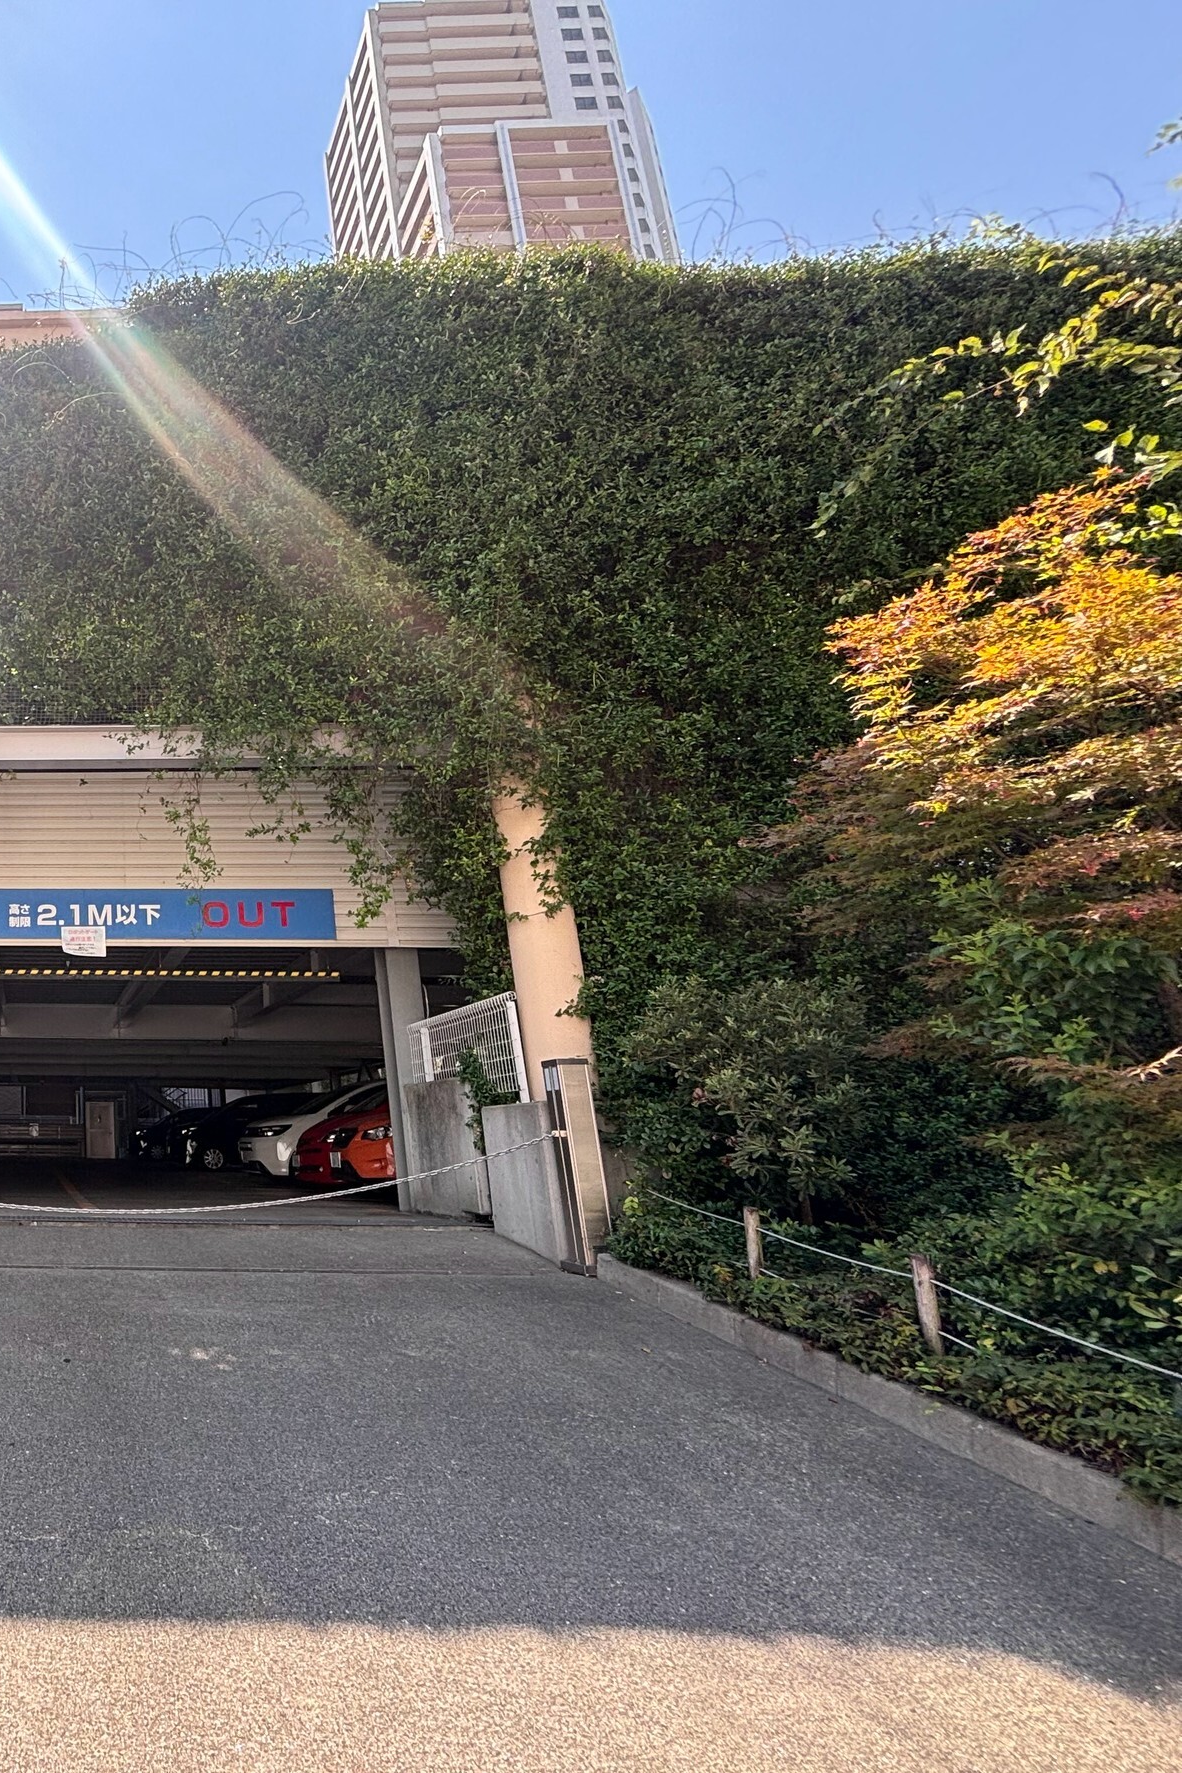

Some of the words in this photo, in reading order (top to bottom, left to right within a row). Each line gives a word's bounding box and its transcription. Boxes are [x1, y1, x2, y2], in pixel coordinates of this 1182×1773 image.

[8, 904, 31, 915] 高さ
[37, 904, 161, 926] 2.1M以下
[202, 901, 296, 928] OUT
[8, 916, 31, 928] 制限
